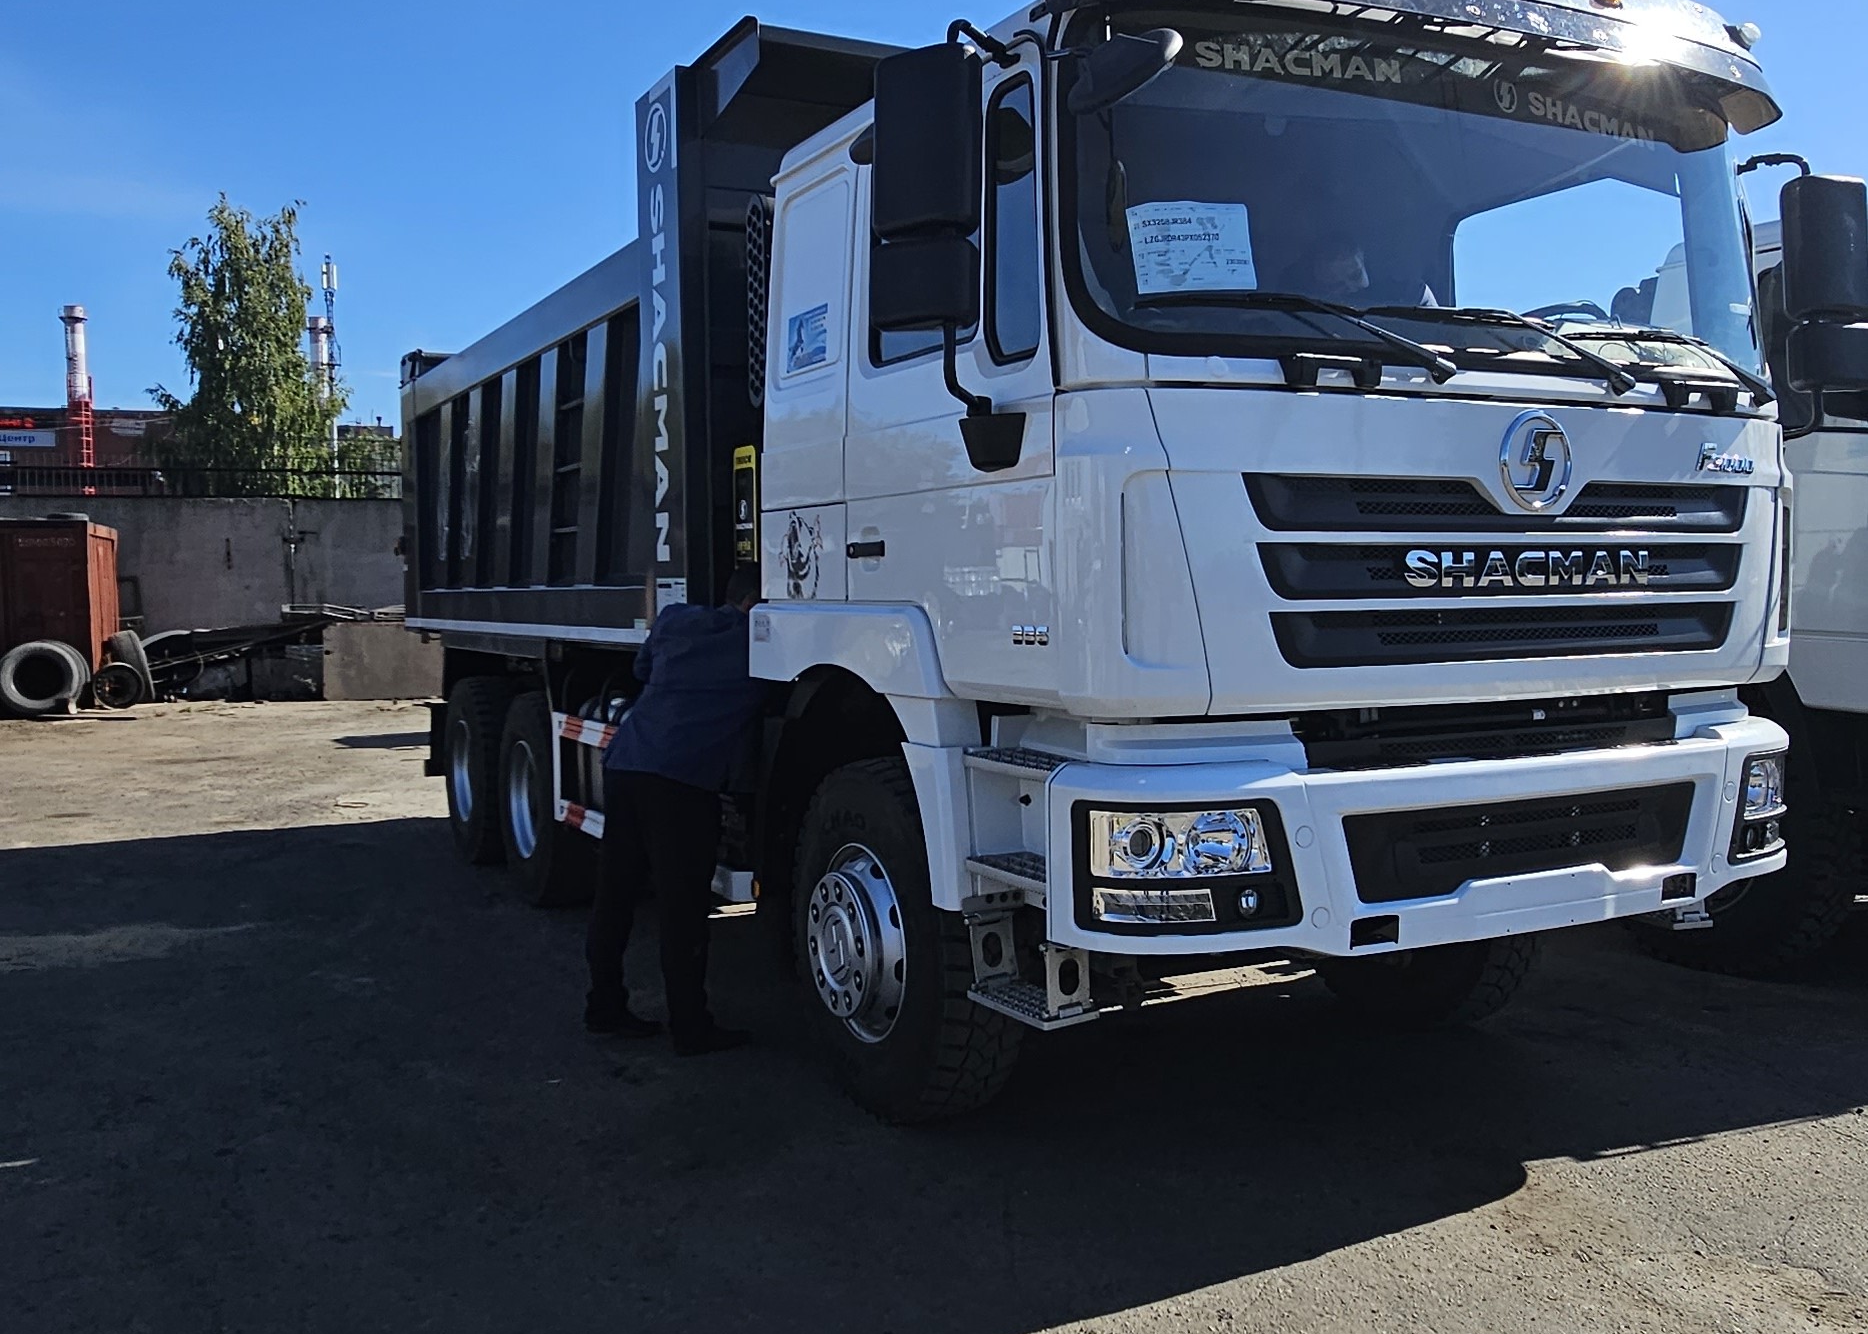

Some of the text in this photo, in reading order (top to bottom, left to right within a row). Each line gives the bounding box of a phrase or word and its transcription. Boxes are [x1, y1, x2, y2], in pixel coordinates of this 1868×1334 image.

[1195, 41, 1402, 84] SHACMAN
[1527, 91, 1655, 151] SHACMAN
[650, 183, 671, 562] SHACMAN
[1404, 549, 1650, 588] SHACMAN
